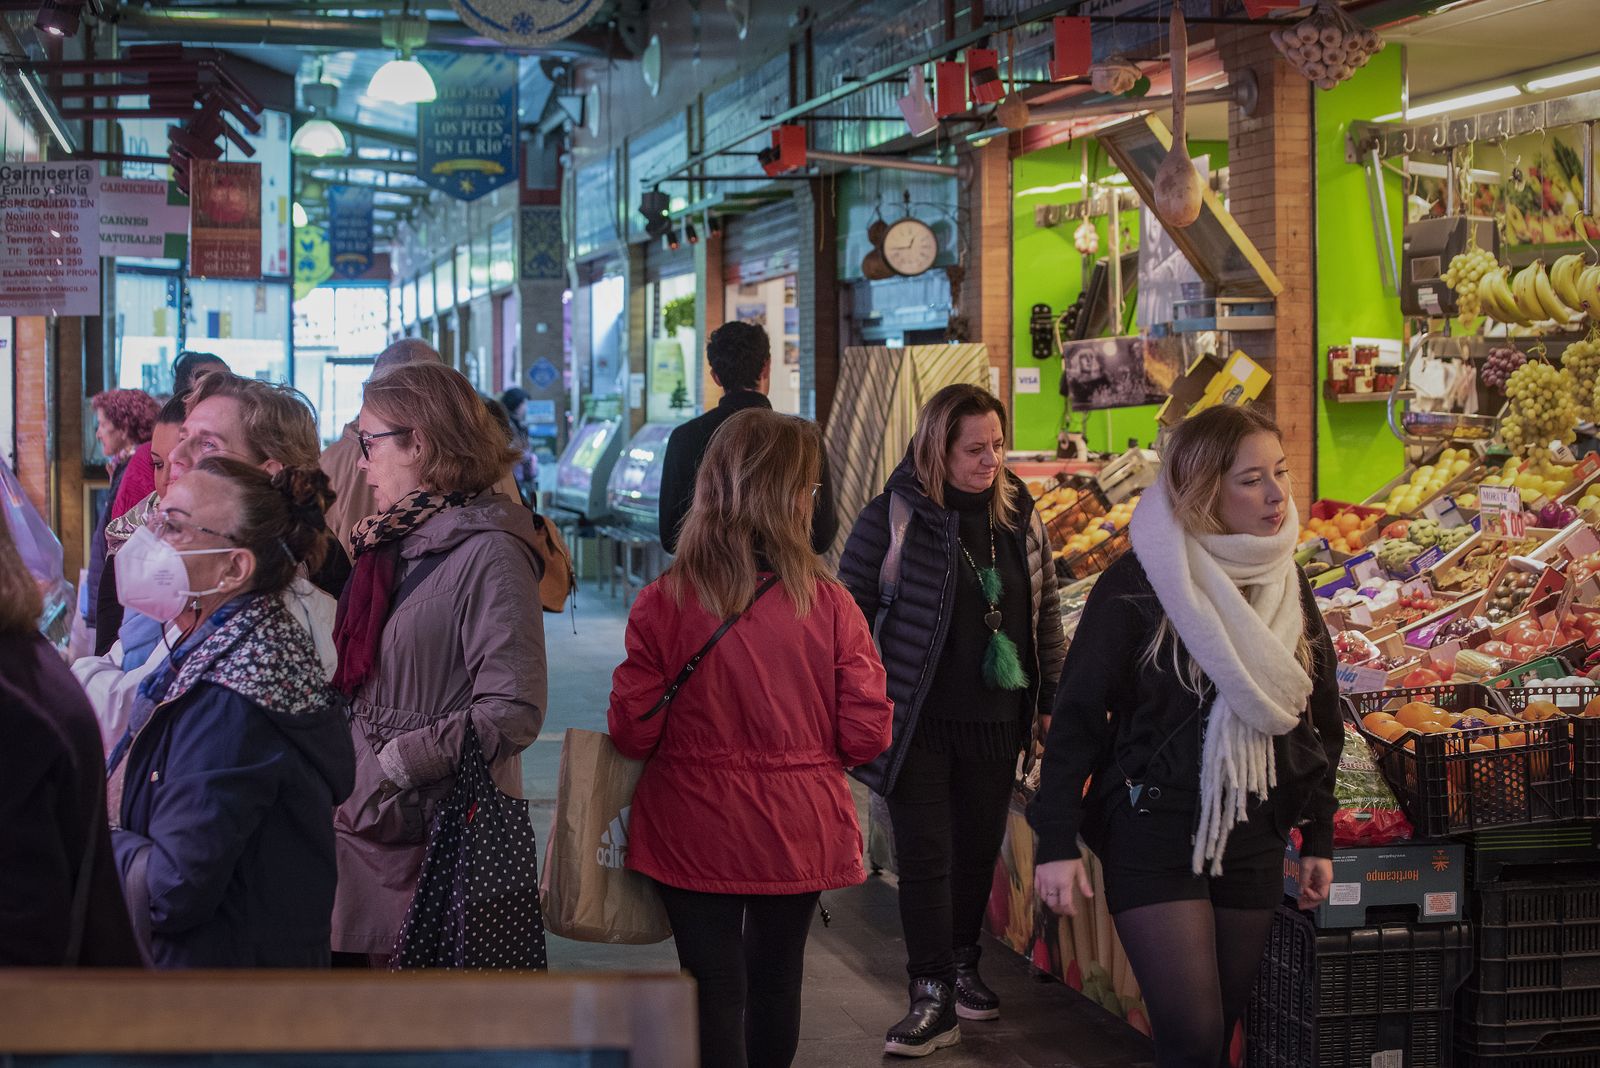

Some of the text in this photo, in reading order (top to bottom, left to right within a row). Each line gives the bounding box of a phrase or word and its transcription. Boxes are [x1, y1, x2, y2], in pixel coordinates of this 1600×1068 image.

[434, 120, 503, 136] LOS PECES
[2, 184, 87, 198] Emilio y Silvia
[80, 199, 95, 208] EN
[6, 211, 40, 220] Novillo
[43, 211, 55, 220] de
[100, 215, 148, 226] CARNES
[6, 223, 44, 232] Ganado
[99, 233, 163, 245] NATURALES
[28, 247, 43, 255] 954
[1018, 376, 1038, 384] VISA
[1366, 869, 1419, 883] Horticampo
